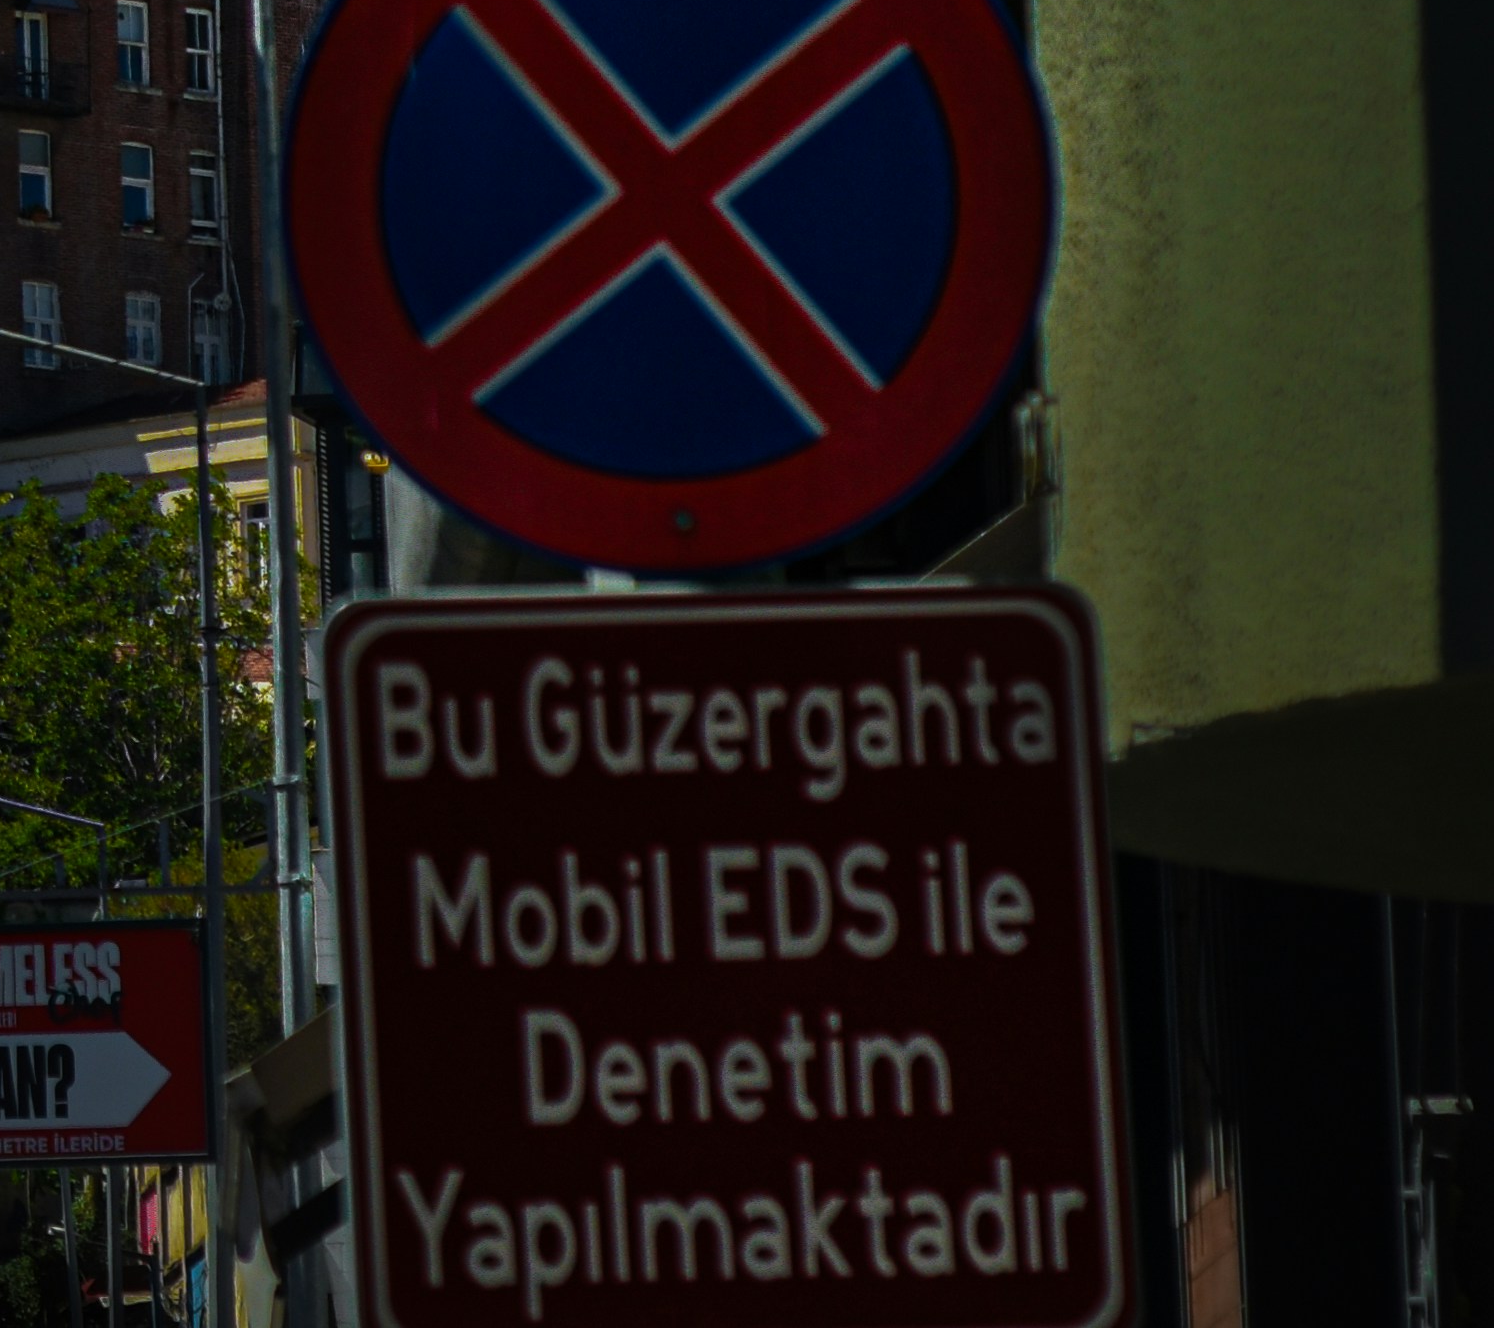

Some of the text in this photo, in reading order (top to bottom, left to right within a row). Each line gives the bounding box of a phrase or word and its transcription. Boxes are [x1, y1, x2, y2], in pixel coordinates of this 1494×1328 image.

[372, 647, 1060, 804] Bu Güzergahta
[408, 836, 1038, 970] Mobil EDS ile
[520, 1006, 956, 1128] Denetim
[54, 1131, 126, 1154] İLERİDE
[391, 1150, 1090, 1324] Yapılmaktadır
